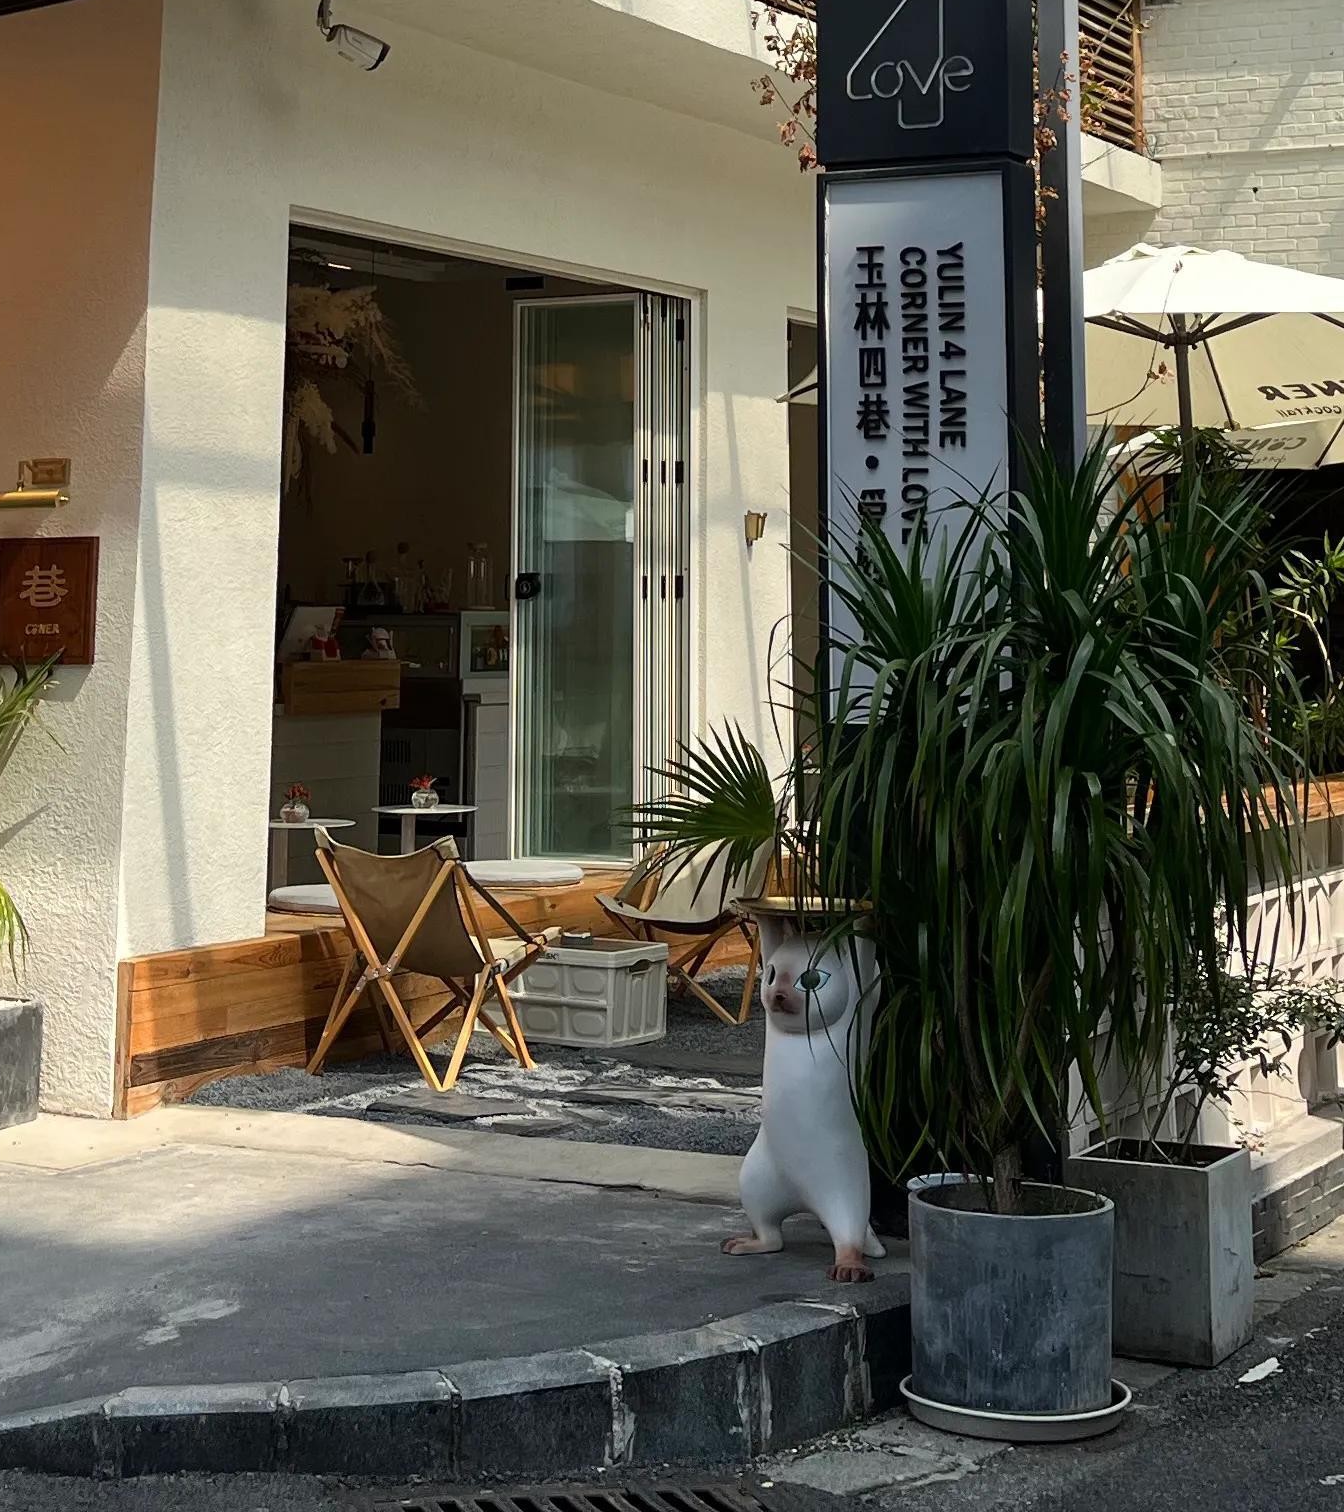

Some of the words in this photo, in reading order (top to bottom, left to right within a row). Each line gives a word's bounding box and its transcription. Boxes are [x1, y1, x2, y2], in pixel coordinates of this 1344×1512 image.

[899, 246, 928, 374] CORNER
[937, 241, 965, 331] YULIN
[939, 340, 966, 359] 4
[903, 381, 929, 457] WITH
[939, 370, 967, 448] LANE
[20, 564, 68, 608] 巷
